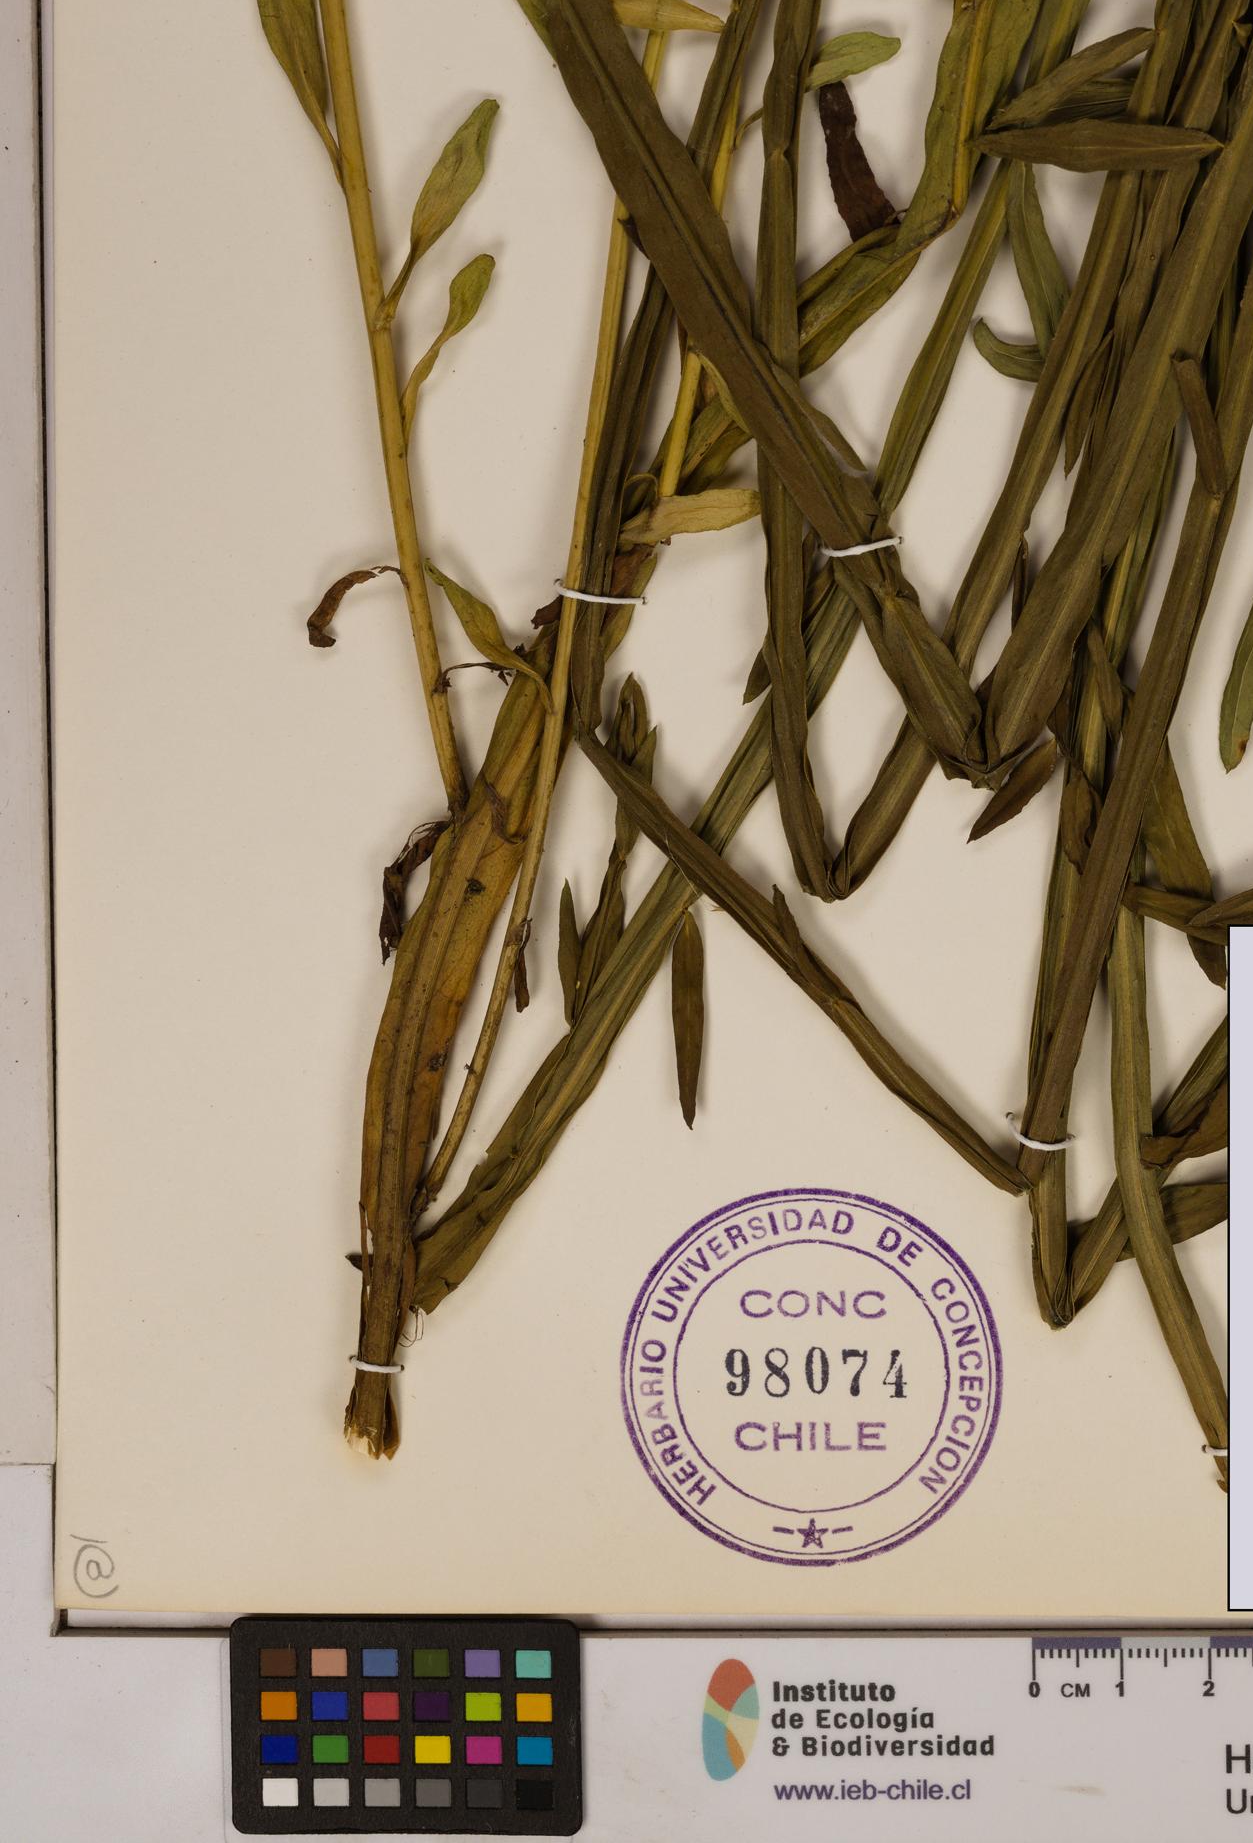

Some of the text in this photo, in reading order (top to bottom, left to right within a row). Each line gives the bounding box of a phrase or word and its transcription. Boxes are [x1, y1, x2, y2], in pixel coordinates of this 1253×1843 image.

[740, 1290, 886, 1318] CONC
[639, 1208, 983, 1505] HERBARIO UNIVERSIDAD DE CONCEPCION
[725, 1347, 907, 1398] 98074
[735, 1422, 886, 1451] CHILE
[773, 1679, 895, 1702] Instituto
[1028, 1681, 1040, 1699] 0
[1060, 1682, 1091, 1699] CM
[1115, 1681, 1126, 1698] 1
[1202, 1680, 1215, 1698] 2
[772, 1708, 935, 1733] de Ecología
[772, 1735, 994, 1757] & Biodiversidad
[774, 1779, 970, 1800] www.ieb-chile.cl
